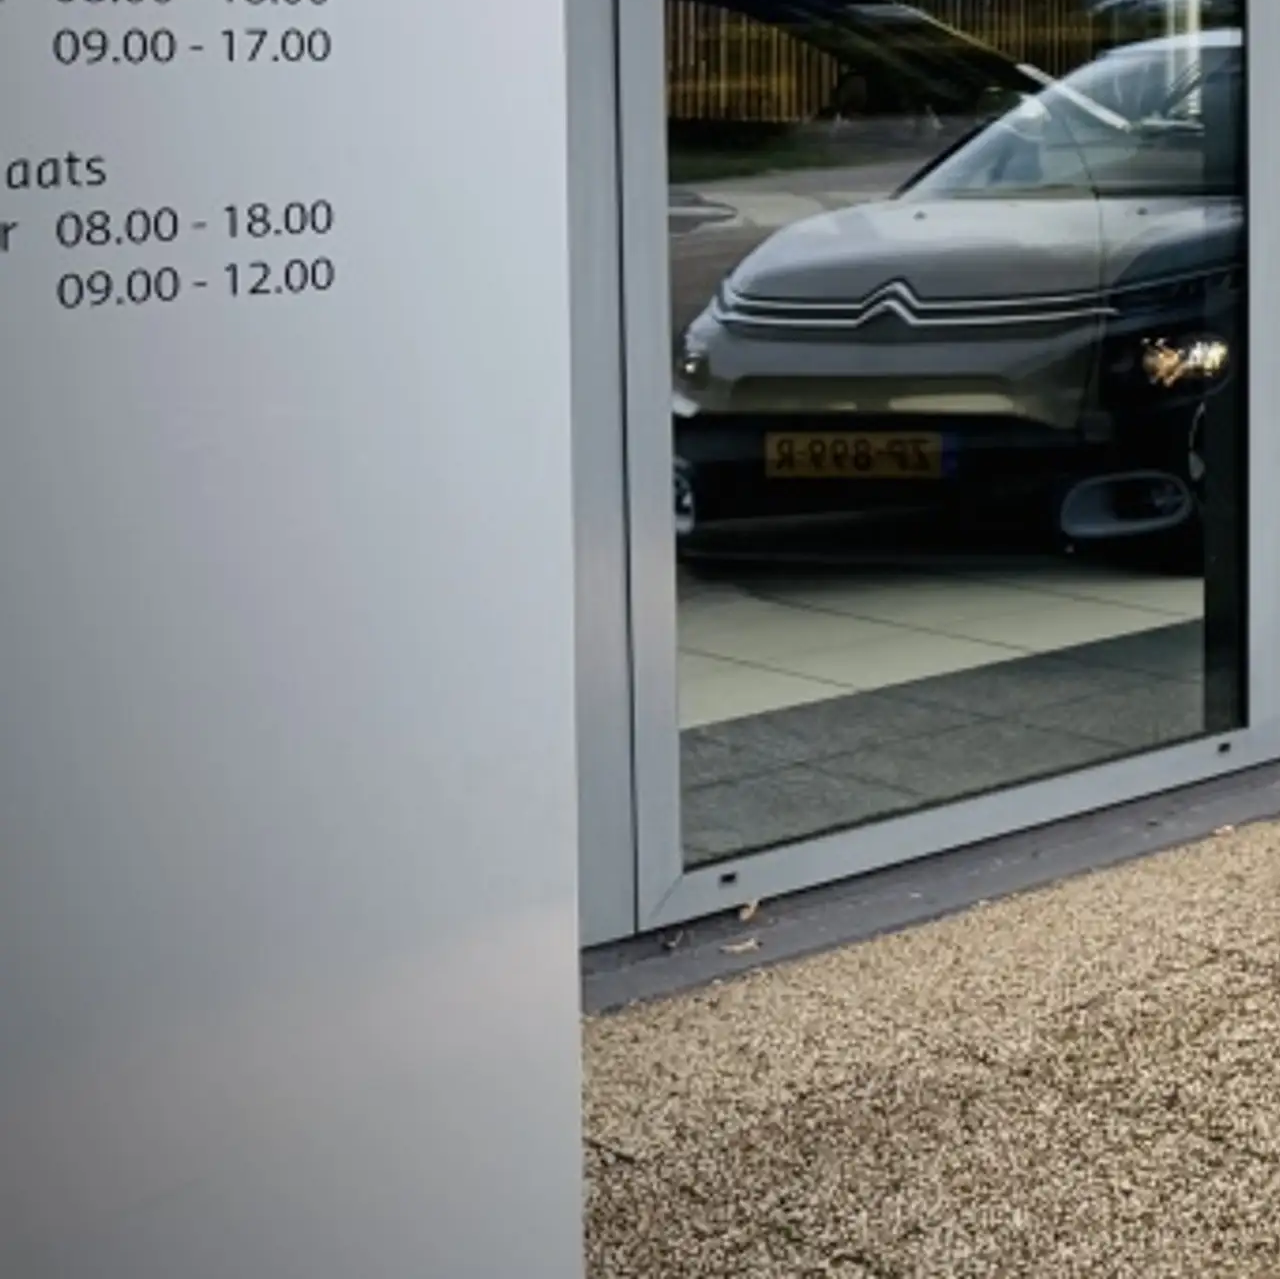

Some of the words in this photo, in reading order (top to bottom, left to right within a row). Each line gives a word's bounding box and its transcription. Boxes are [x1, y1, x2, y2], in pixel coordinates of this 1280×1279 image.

[52, 27, 177, 66] 09.00
[221, 26, 332, 63] 17.00
[4, 150, 107, 190] aats
[55, 206, 179, 249] 08.00
[224, 198, 335, 239] 18.00
[56, 265, 181, 310] 09.00
[224, 255, 335, 298] 12.00
